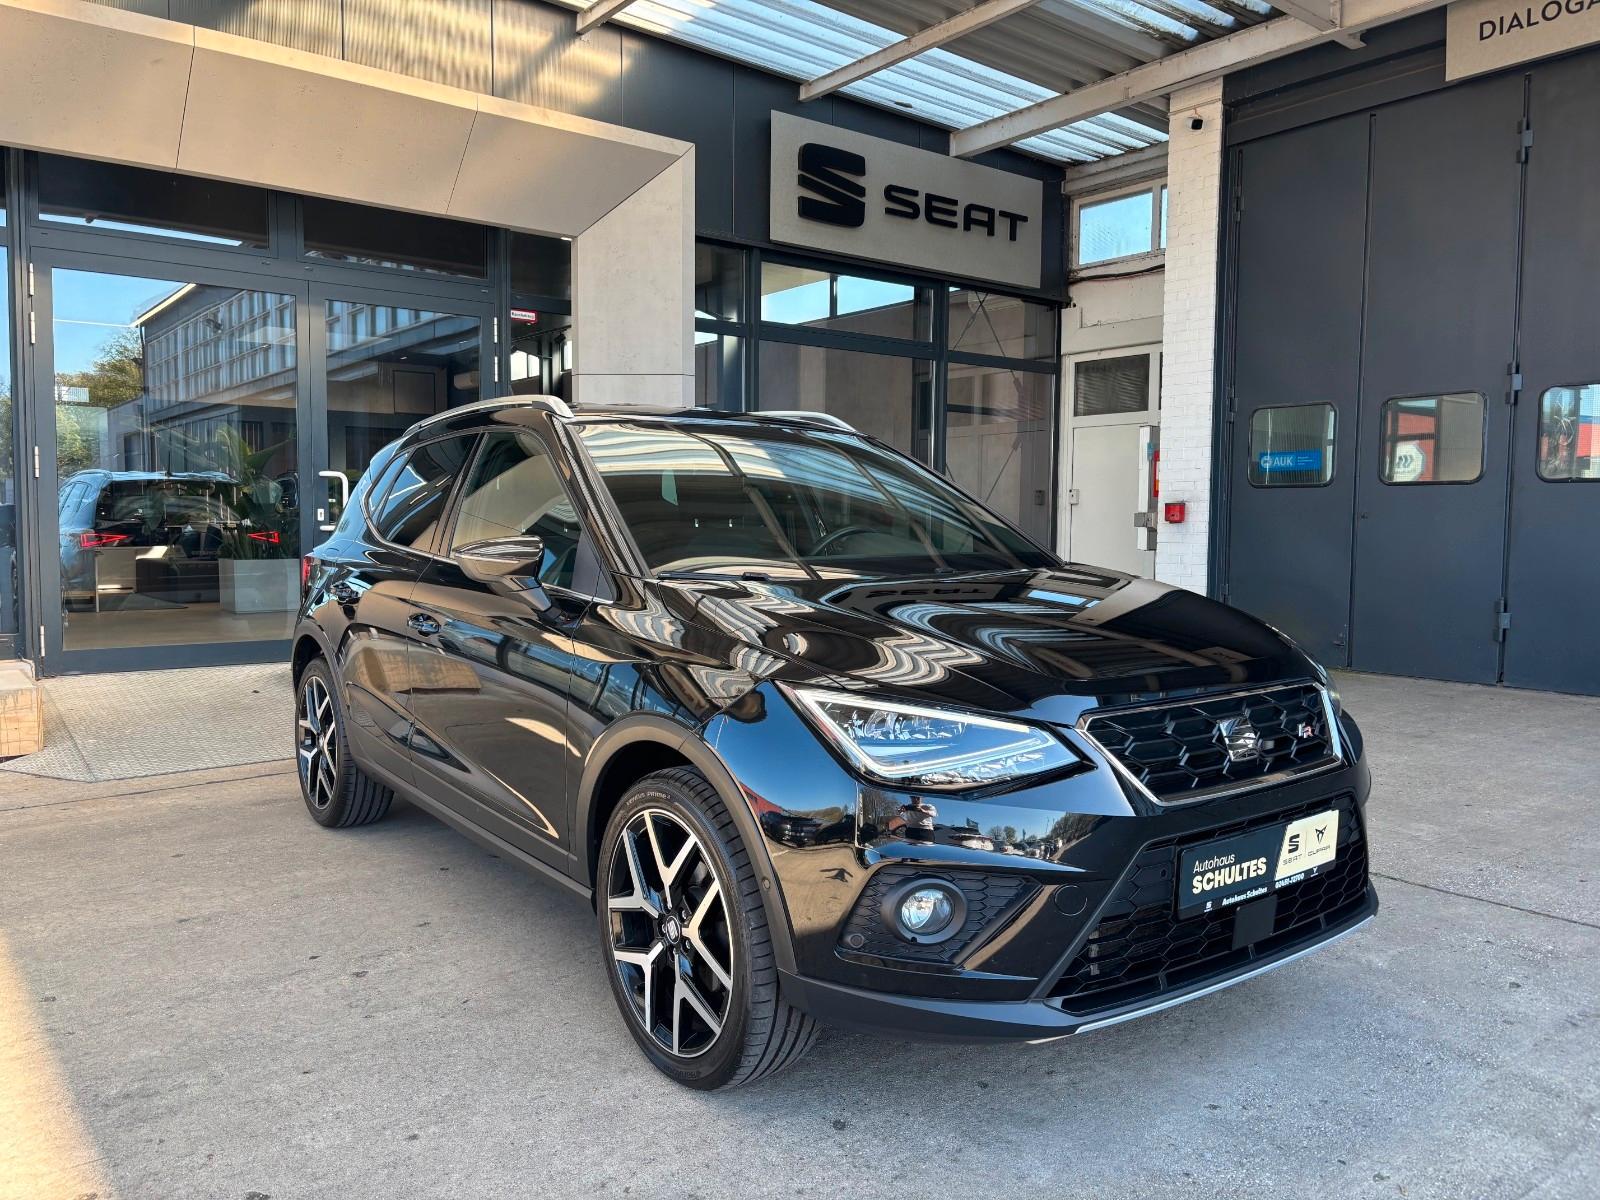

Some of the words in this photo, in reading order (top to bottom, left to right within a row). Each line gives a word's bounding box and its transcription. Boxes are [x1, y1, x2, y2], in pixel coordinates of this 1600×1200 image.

[884, 184, 1029, 242] SEAT
[1273, 456, 1293, 466] AUK
[1192, 857, 1267, 894] SCHULTES
[1193, 854, 1235, 874] Autohaus
